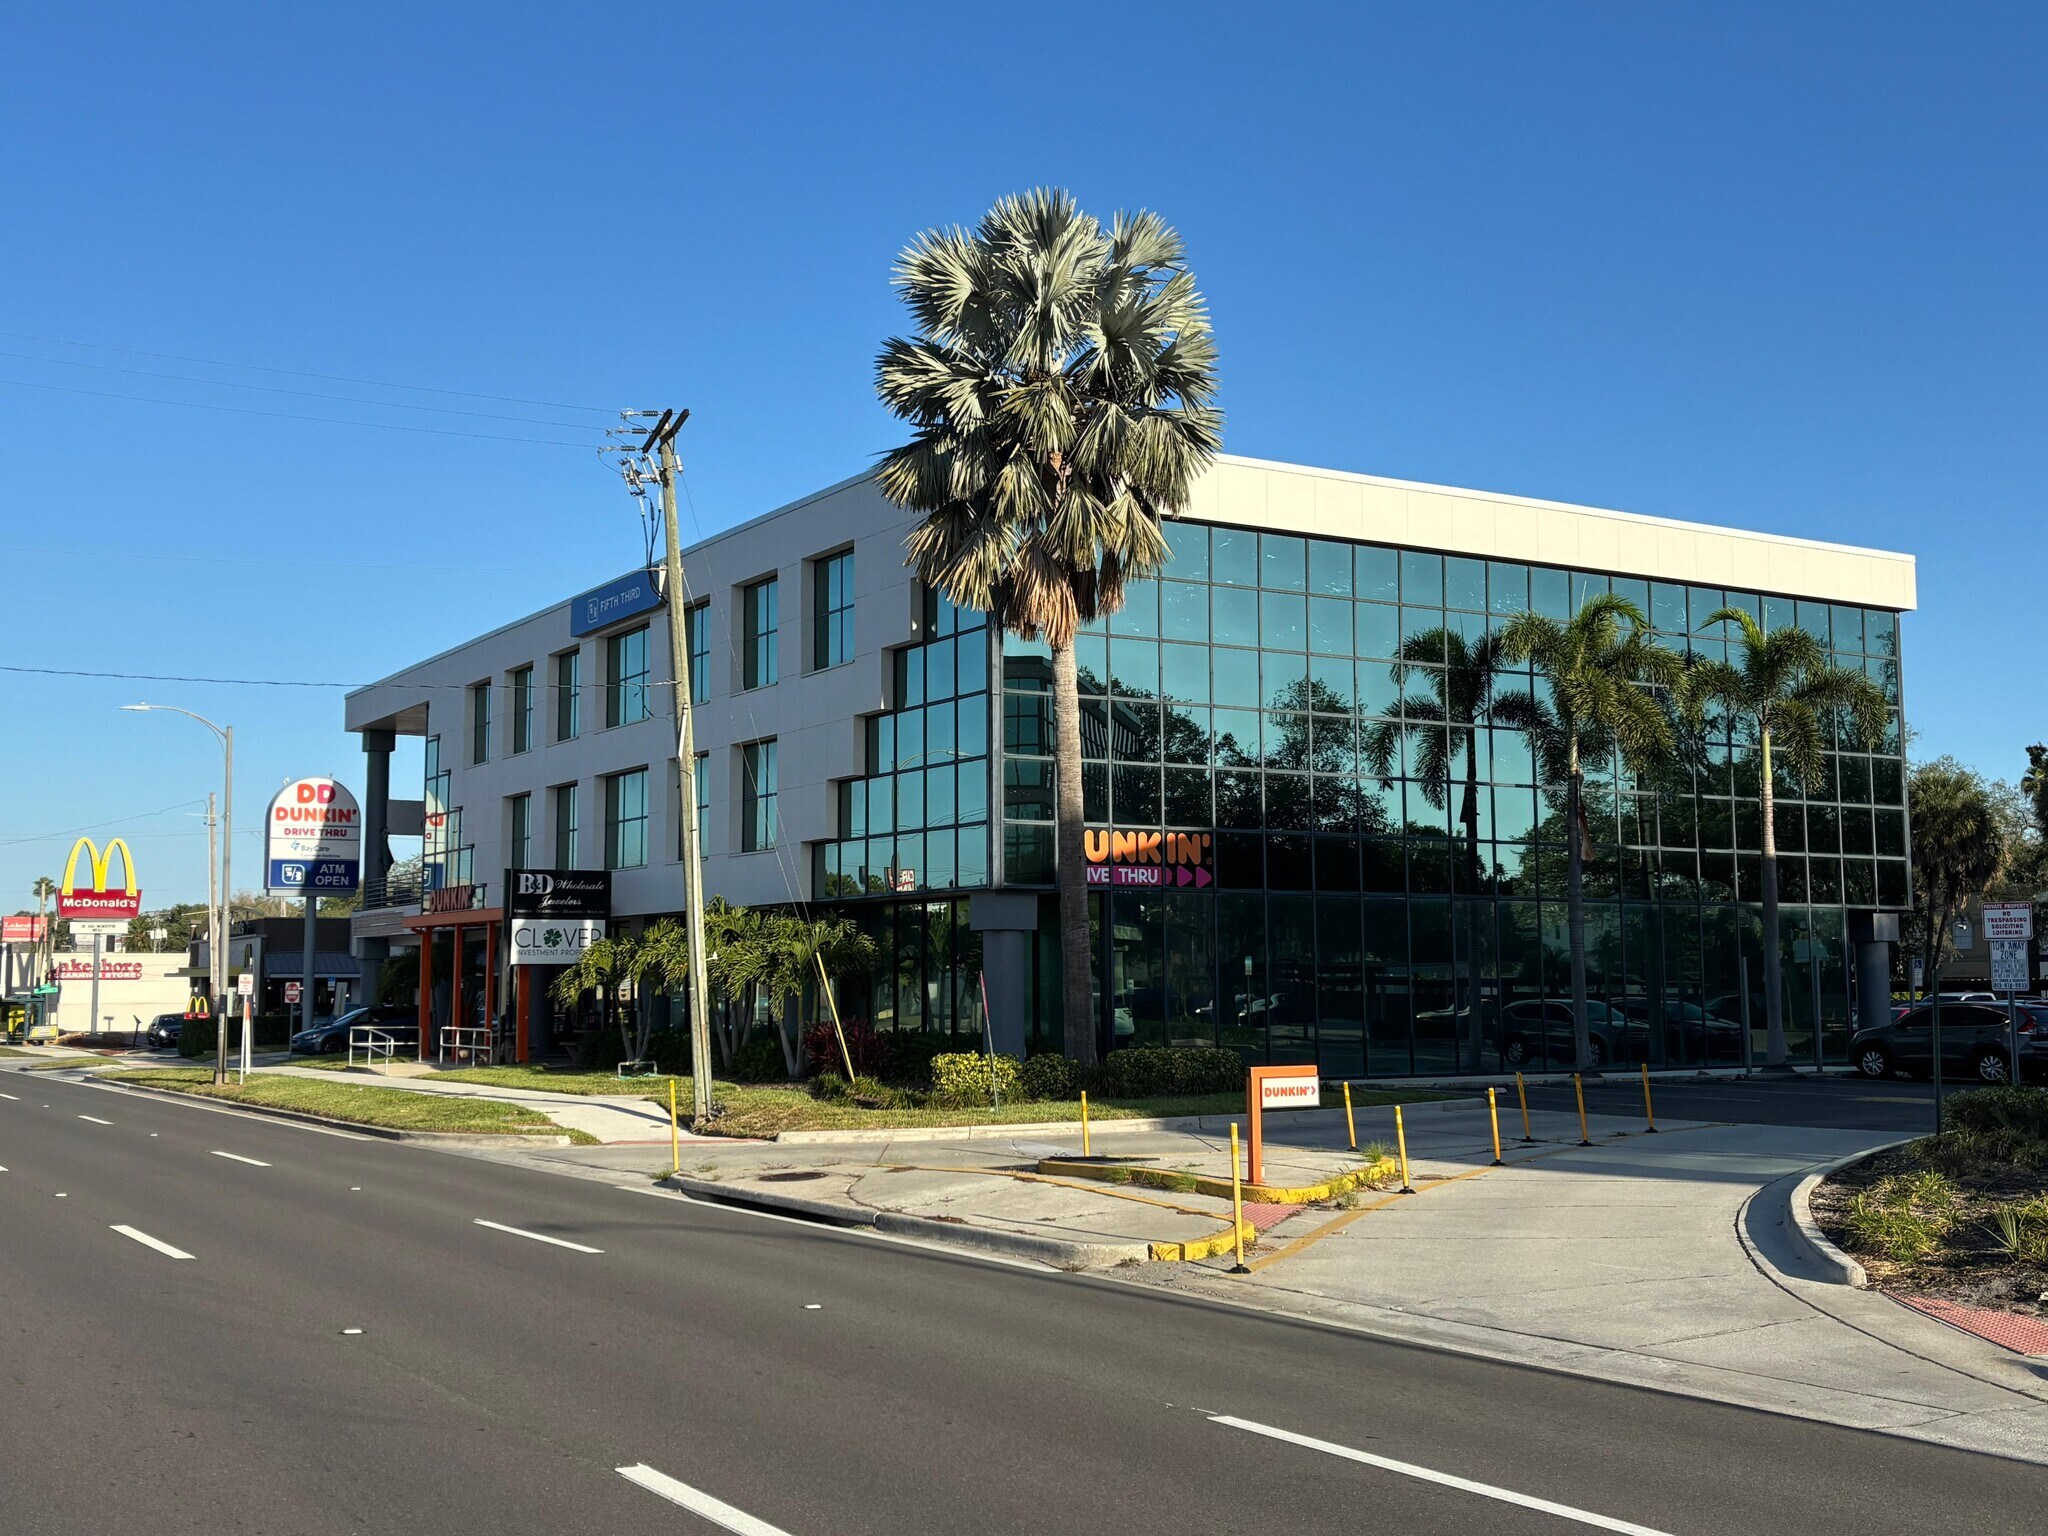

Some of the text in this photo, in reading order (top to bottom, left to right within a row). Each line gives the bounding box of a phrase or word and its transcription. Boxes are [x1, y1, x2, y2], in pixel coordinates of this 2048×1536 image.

[600, 595, 619, 613] FIFTH
[620, 587, 641, 604] THIRD
[275, 806, 357, 823] DUNKIN'
[284, 827, 348, 837] DRIVE THRU
[1083, 829, 1211, 865] UNKIN'
[319, 864, 345, 874] ATM
[1086, 867, 1158, 883] IVE THRU
[315, 875, 349, 886] OPEN
[517, 873, 605, 895] B&D Wholesale
[62, 898, 137, 908] McDonald's
[538, 894, 582, 909] Jewelers
[1992, 941, 2025, 951] TOW AWAY
[2000, 950, 2018, 960] ZONE
[105, 971, 137, 979] STORE
[1264, 1085, 1310, 1098] DUNKIN'
